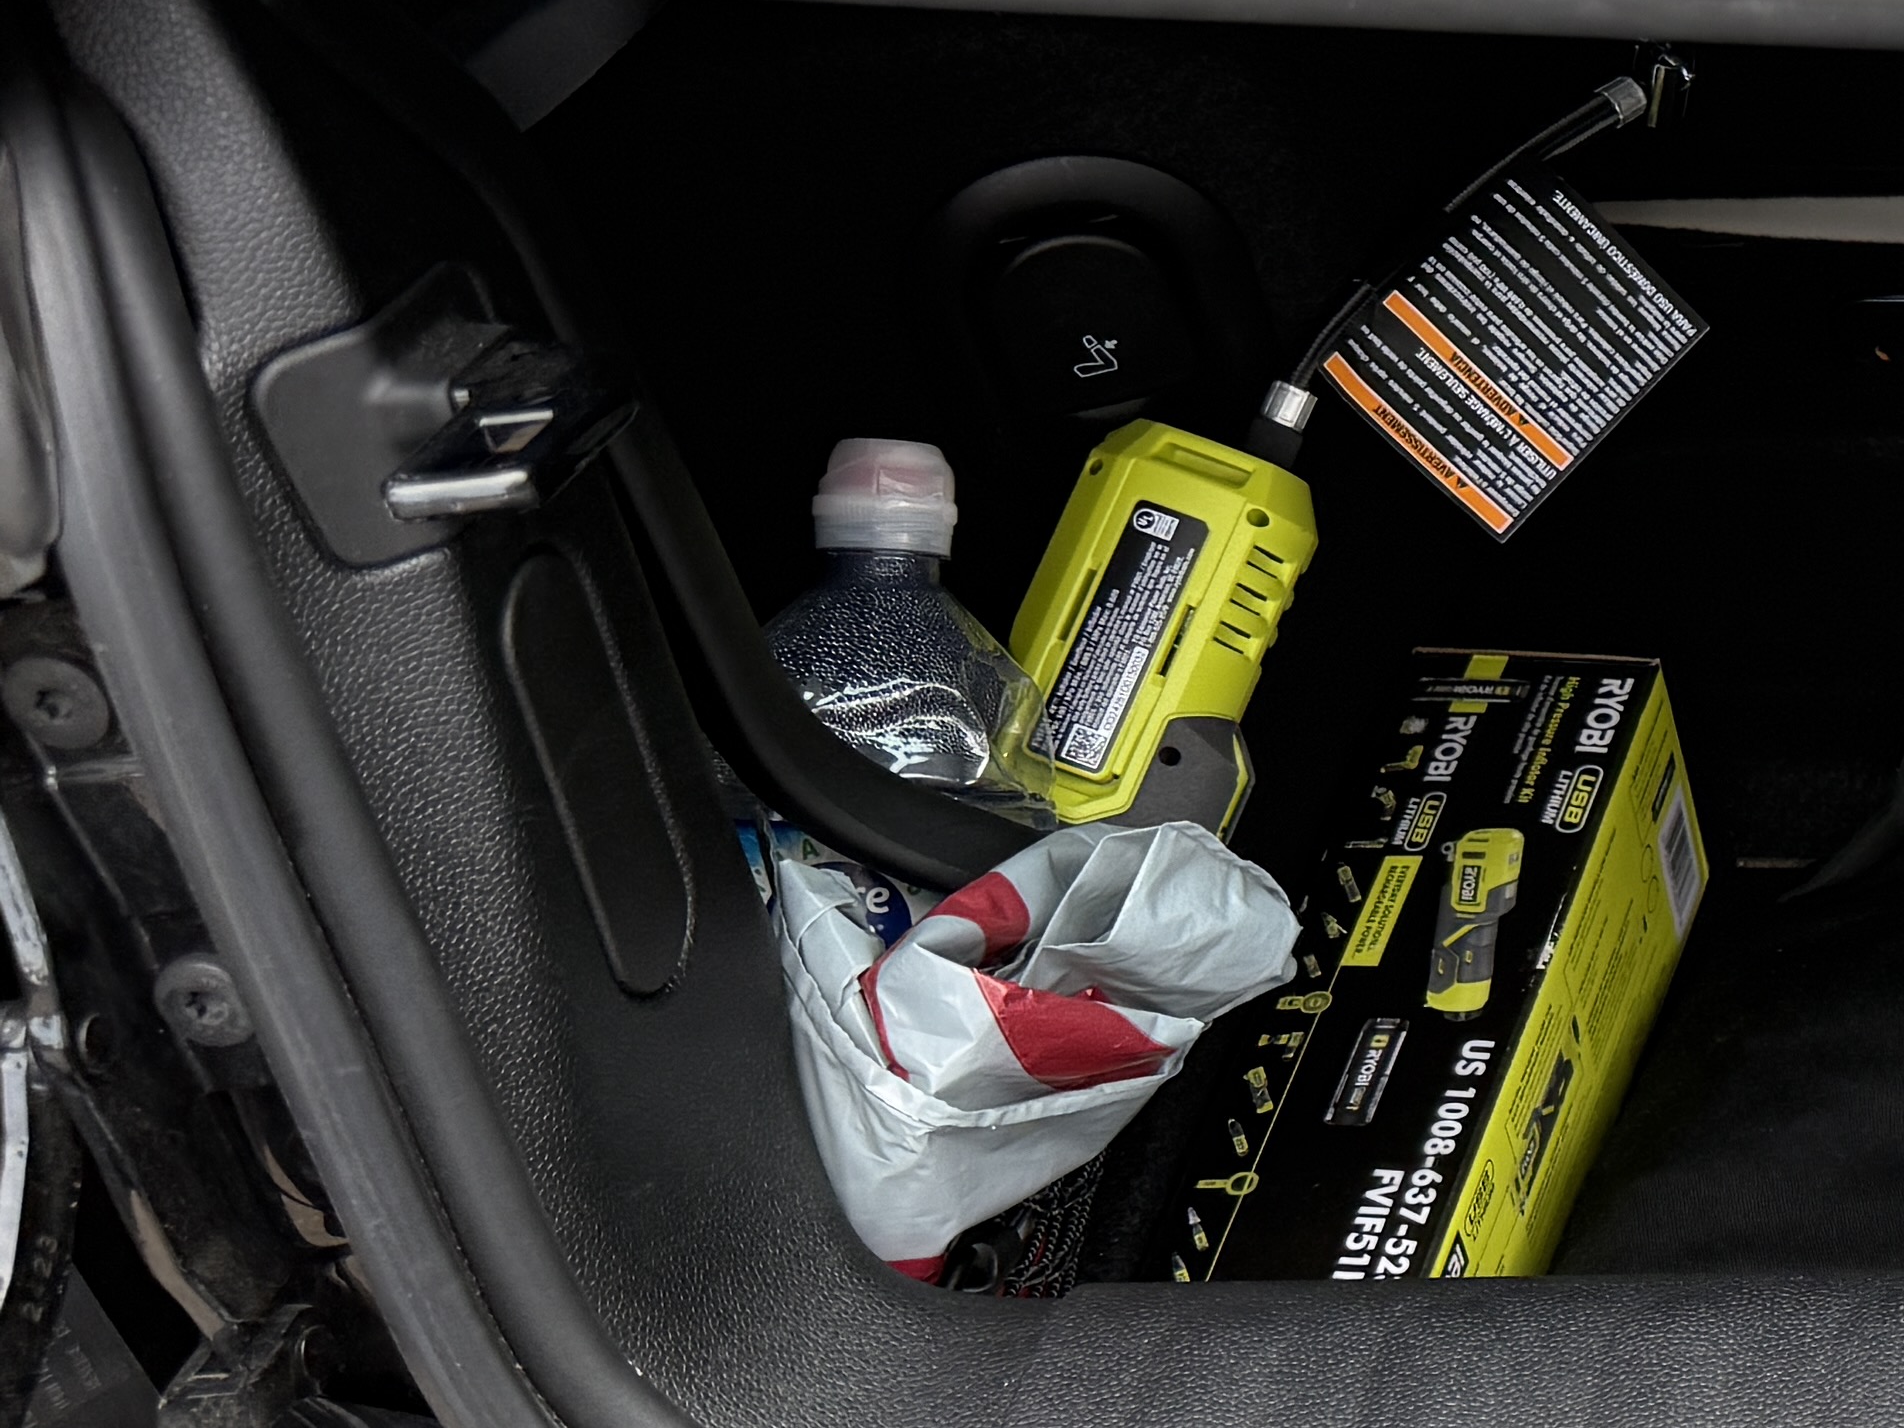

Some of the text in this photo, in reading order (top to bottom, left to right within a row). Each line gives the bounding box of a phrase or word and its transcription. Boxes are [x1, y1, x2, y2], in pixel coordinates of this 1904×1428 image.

[1605, 245, 1657, 296] DOMÉSTICO
[1651, 292, 1674, 314] USO
[1670, 308, 1697, 337] PARA
[1414, 346, 1470, 399] SEULEMENT.
[1451, 352, 1518, 417] ADVERTENCIA
[1374, 405, 1455, 480] AVERTISSEMENT
[1507, 433, 1521, 447] À
[1515, 441, 1557, 480] UTILISER
[1558, 675, 1581, 700] High
[1540, 701, 1570, 745] Pressure
[1574, 677, 1635, 753] RYOBI
[1422, 714, 1477, 781] RYOBI
[1524, 746, 1551, 786] Inflator
[1517, 787, 1535, 803] Kit
[1540, 769, 1573, 824] LITHIUM
[1563, 773, 1596, 823] USB
[1391, 797, 1420, 845] LITHIUM
[1410, 797, 1440, 844] USB
[1354, 1048, 1383, 1086] RYOBI
[1373, 1039, 1495, 1280] US 1008-637-52
